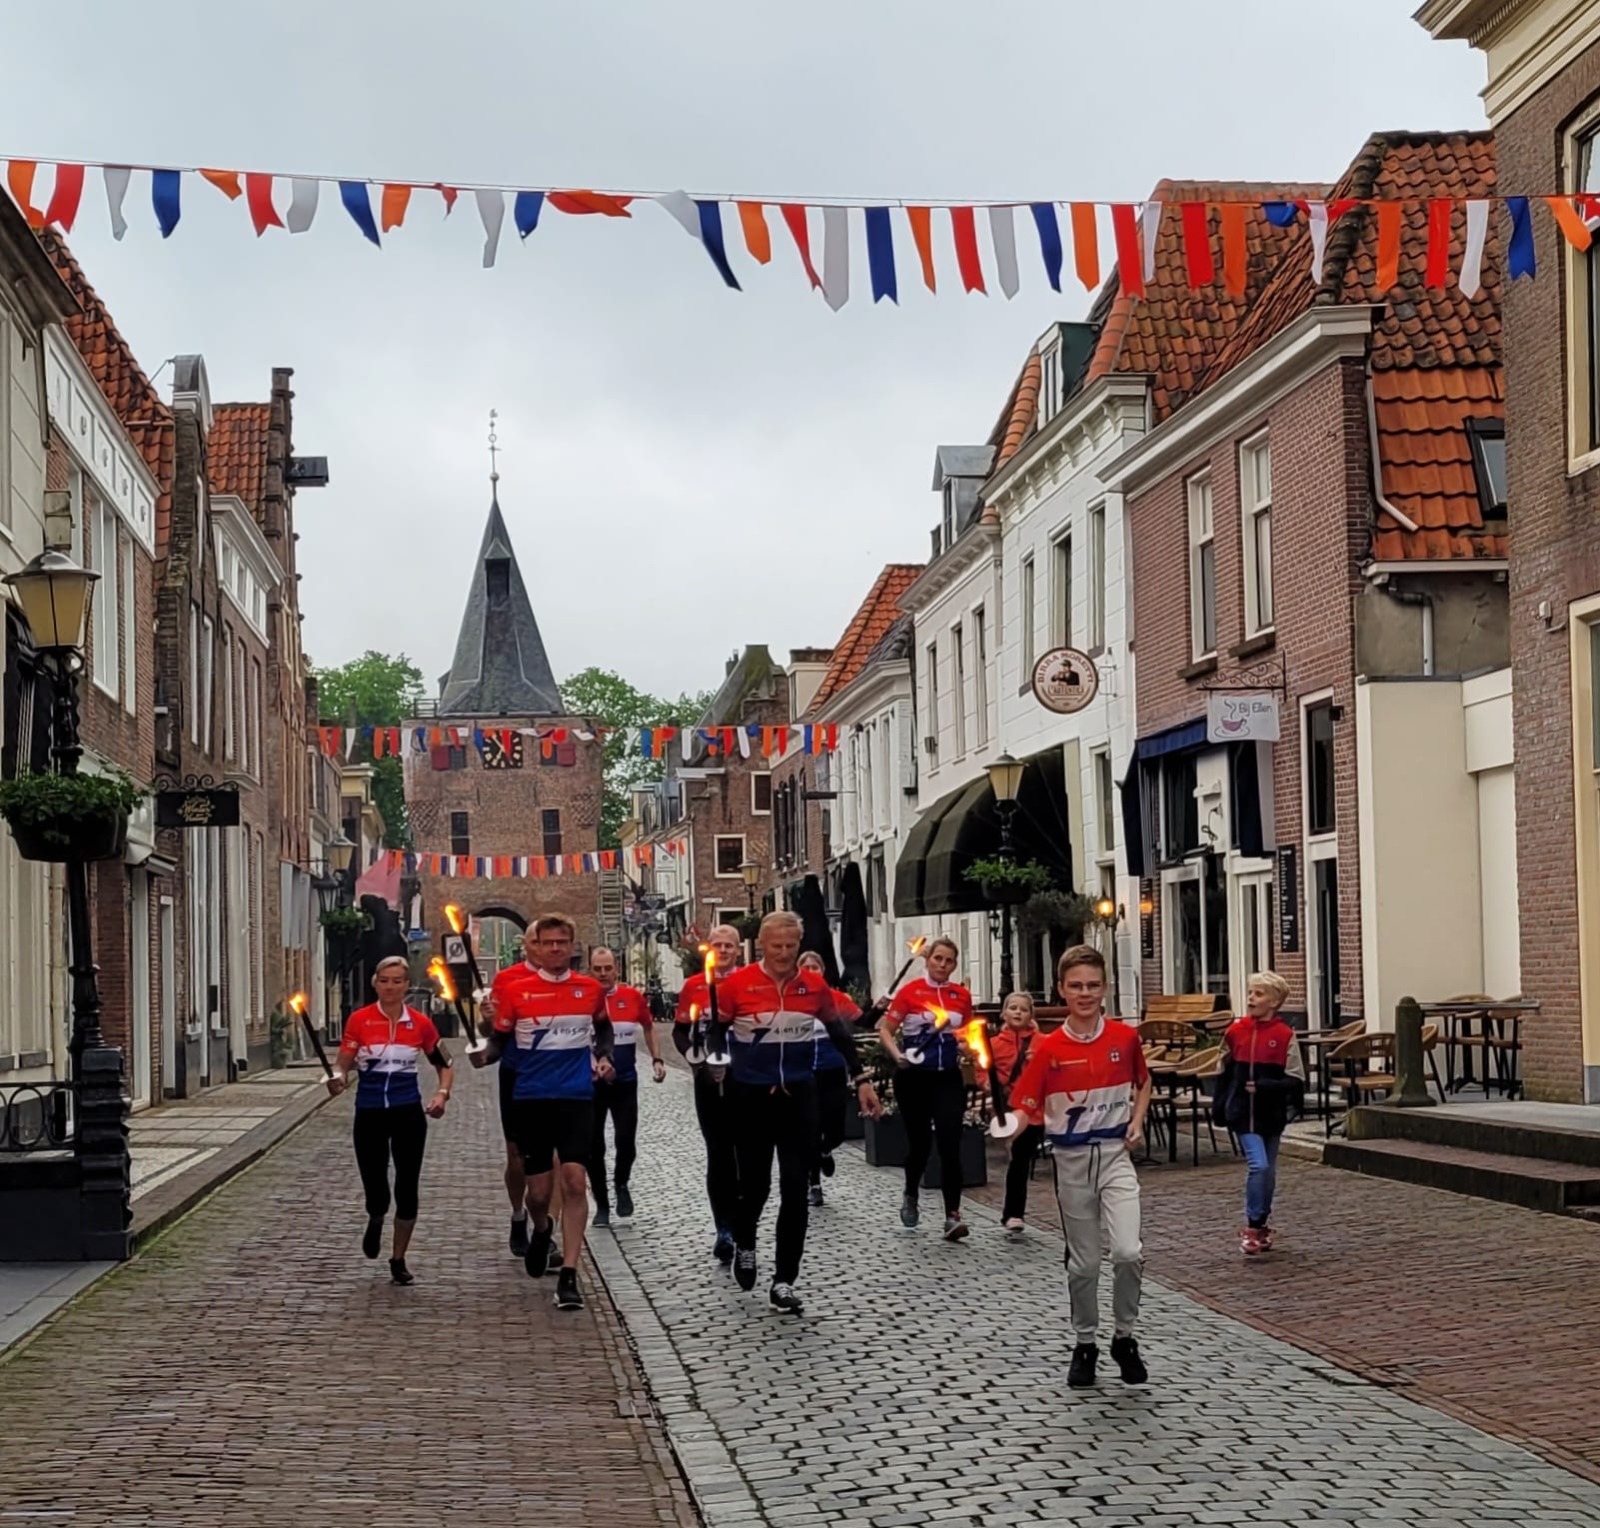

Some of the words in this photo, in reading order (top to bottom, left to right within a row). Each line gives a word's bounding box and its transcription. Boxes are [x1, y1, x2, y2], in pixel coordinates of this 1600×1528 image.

[1037, 654, 1060, 683] BIRRA
[1060, 652, 1094, 683] MORETTI
[1239, 702, 1251, 717] Bij
[1252, 702, 1273, 713] Ellen
